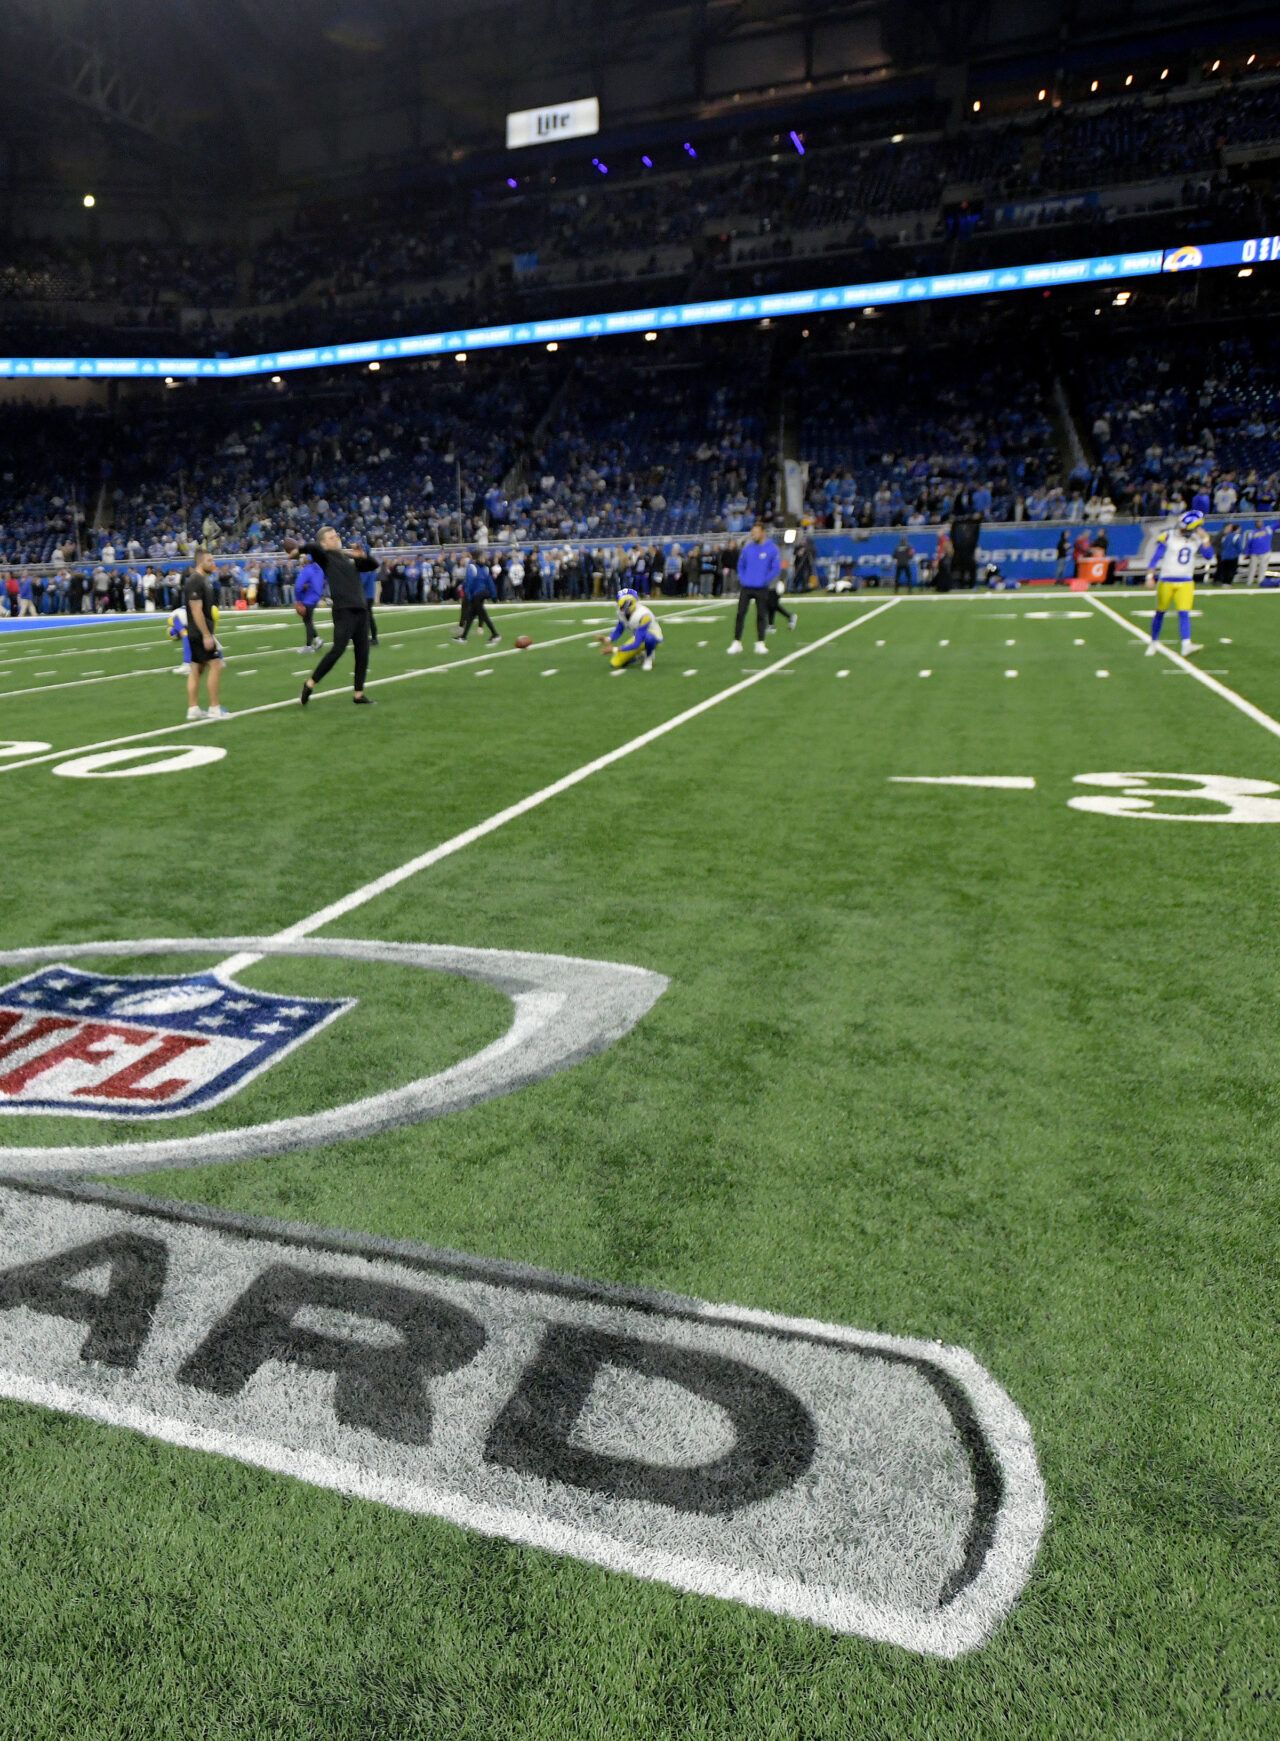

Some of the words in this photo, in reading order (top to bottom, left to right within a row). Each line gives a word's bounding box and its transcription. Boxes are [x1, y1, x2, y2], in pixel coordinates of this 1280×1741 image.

[975, 547, 1058, 563] DETRO
[1177, 547, 1192, 565] 8
[1091, 563, 1104, 576] G
